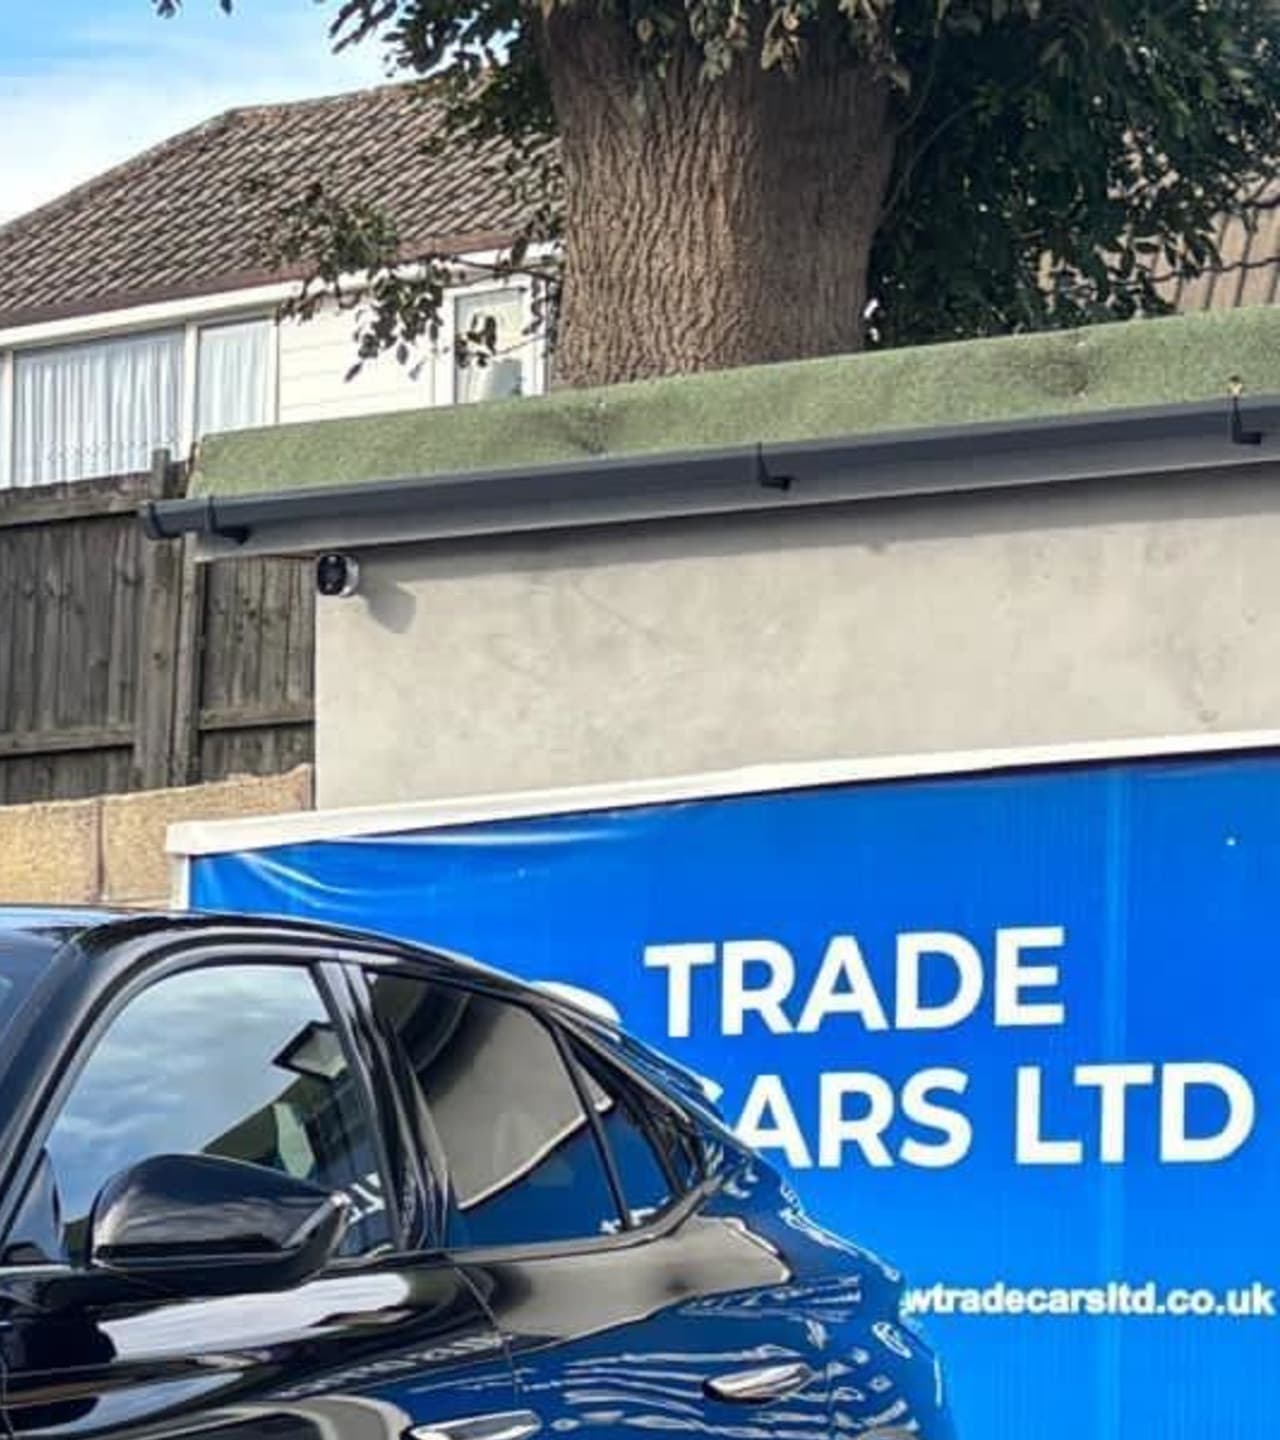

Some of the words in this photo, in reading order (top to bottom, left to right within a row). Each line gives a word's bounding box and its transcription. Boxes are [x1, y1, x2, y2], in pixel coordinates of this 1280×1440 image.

[643, 926, 1065, 1038] TRADE
[702, 1067, 973, 1168] ARS
[1015, 1062, 1256, 1164] LTD
